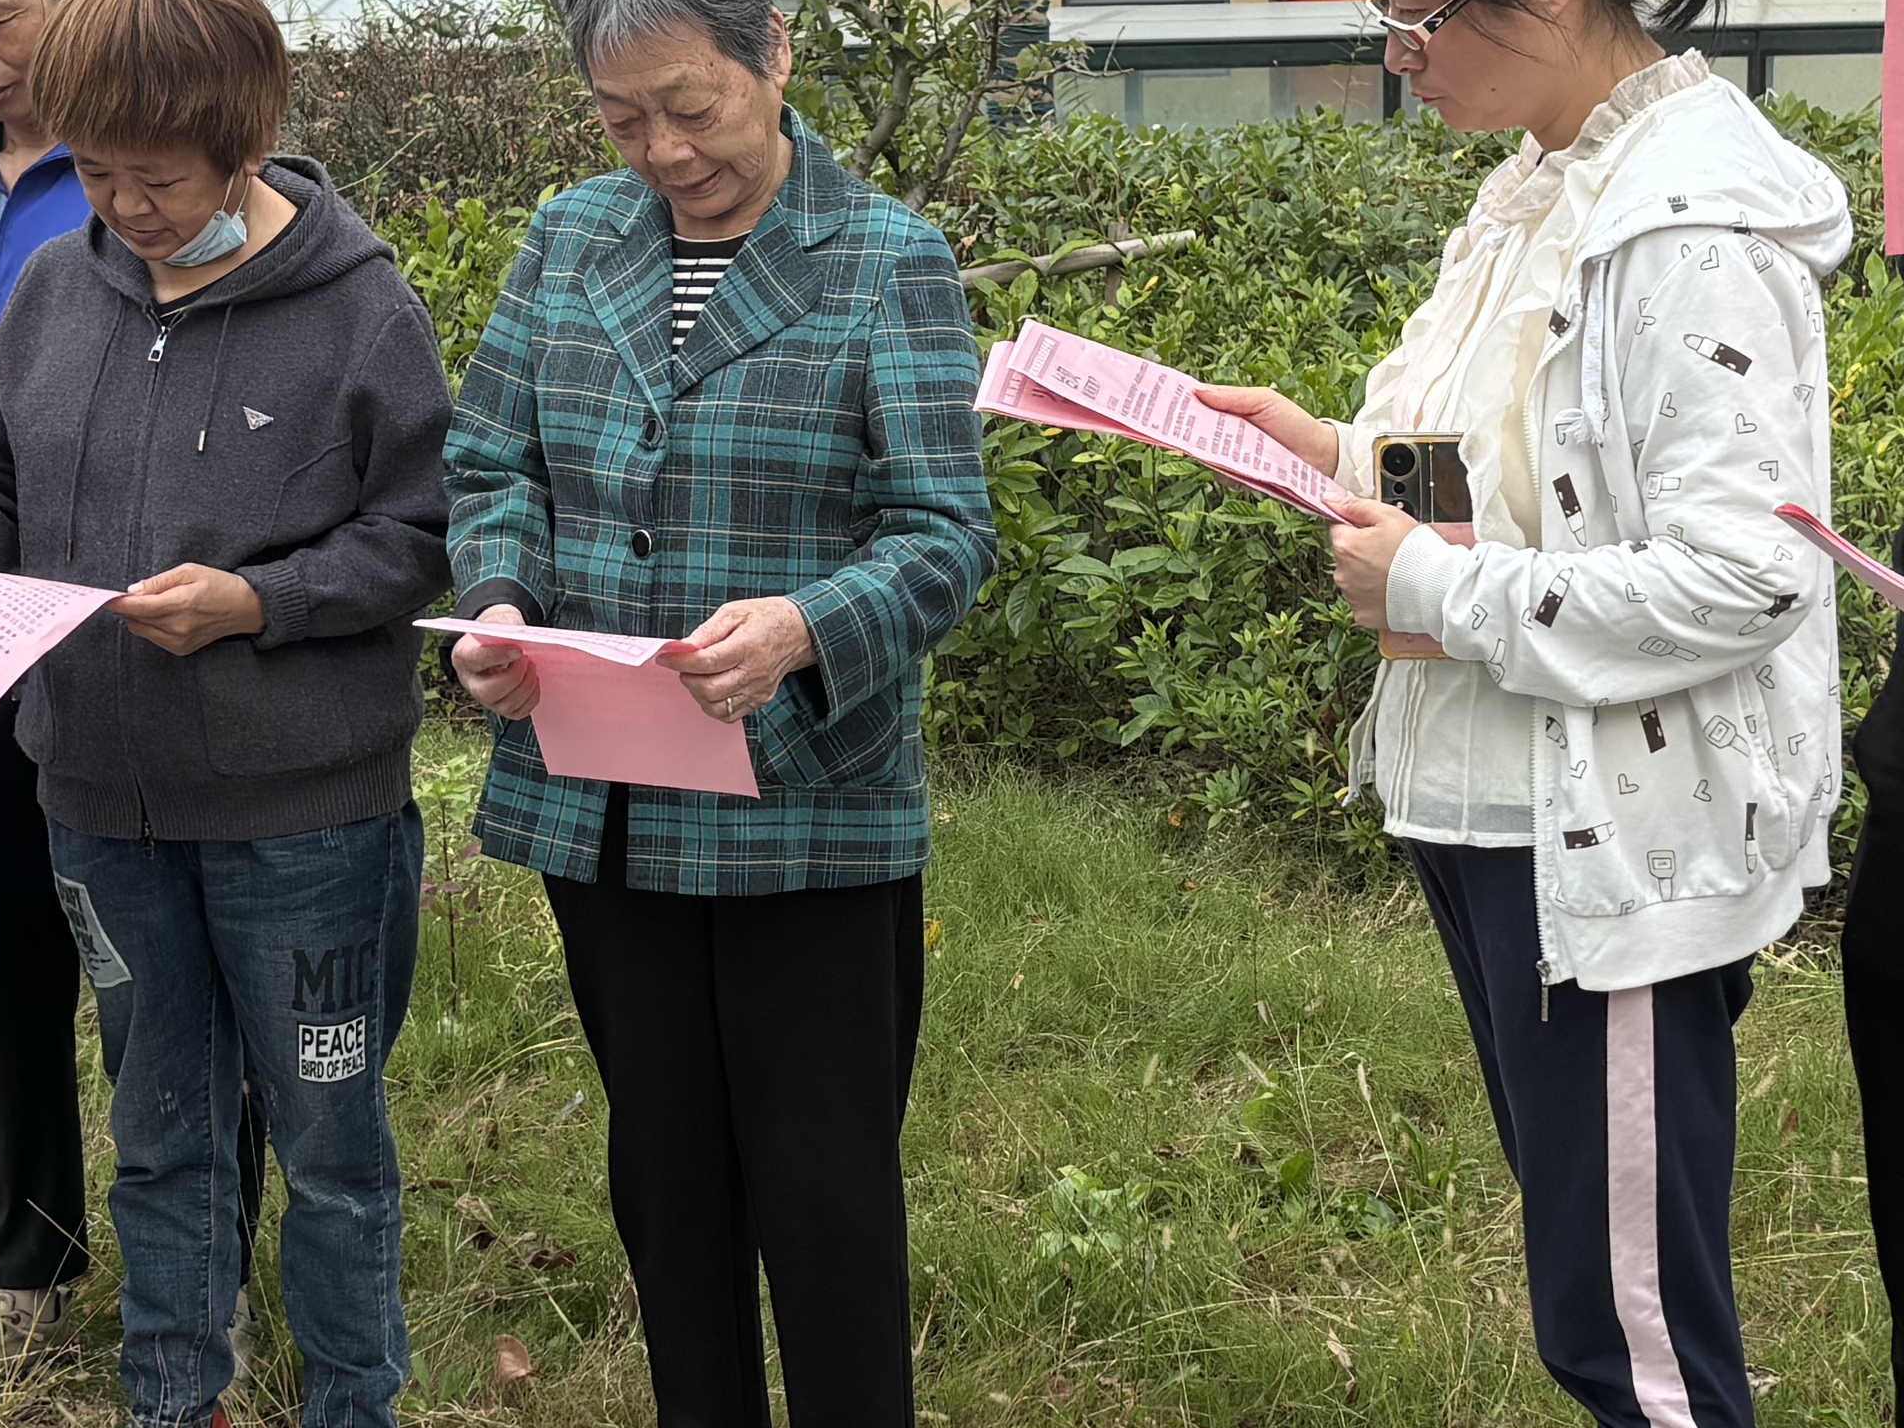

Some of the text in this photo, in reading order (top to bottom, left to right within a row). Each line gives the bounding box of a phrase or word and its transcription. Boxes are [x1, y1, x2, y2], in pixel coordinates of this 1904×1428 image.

[301, 1019, 364, 1059] PEACE
[301, 1058, 325, 1079] BIRD
[326, 1058, 341, 1080] OF
